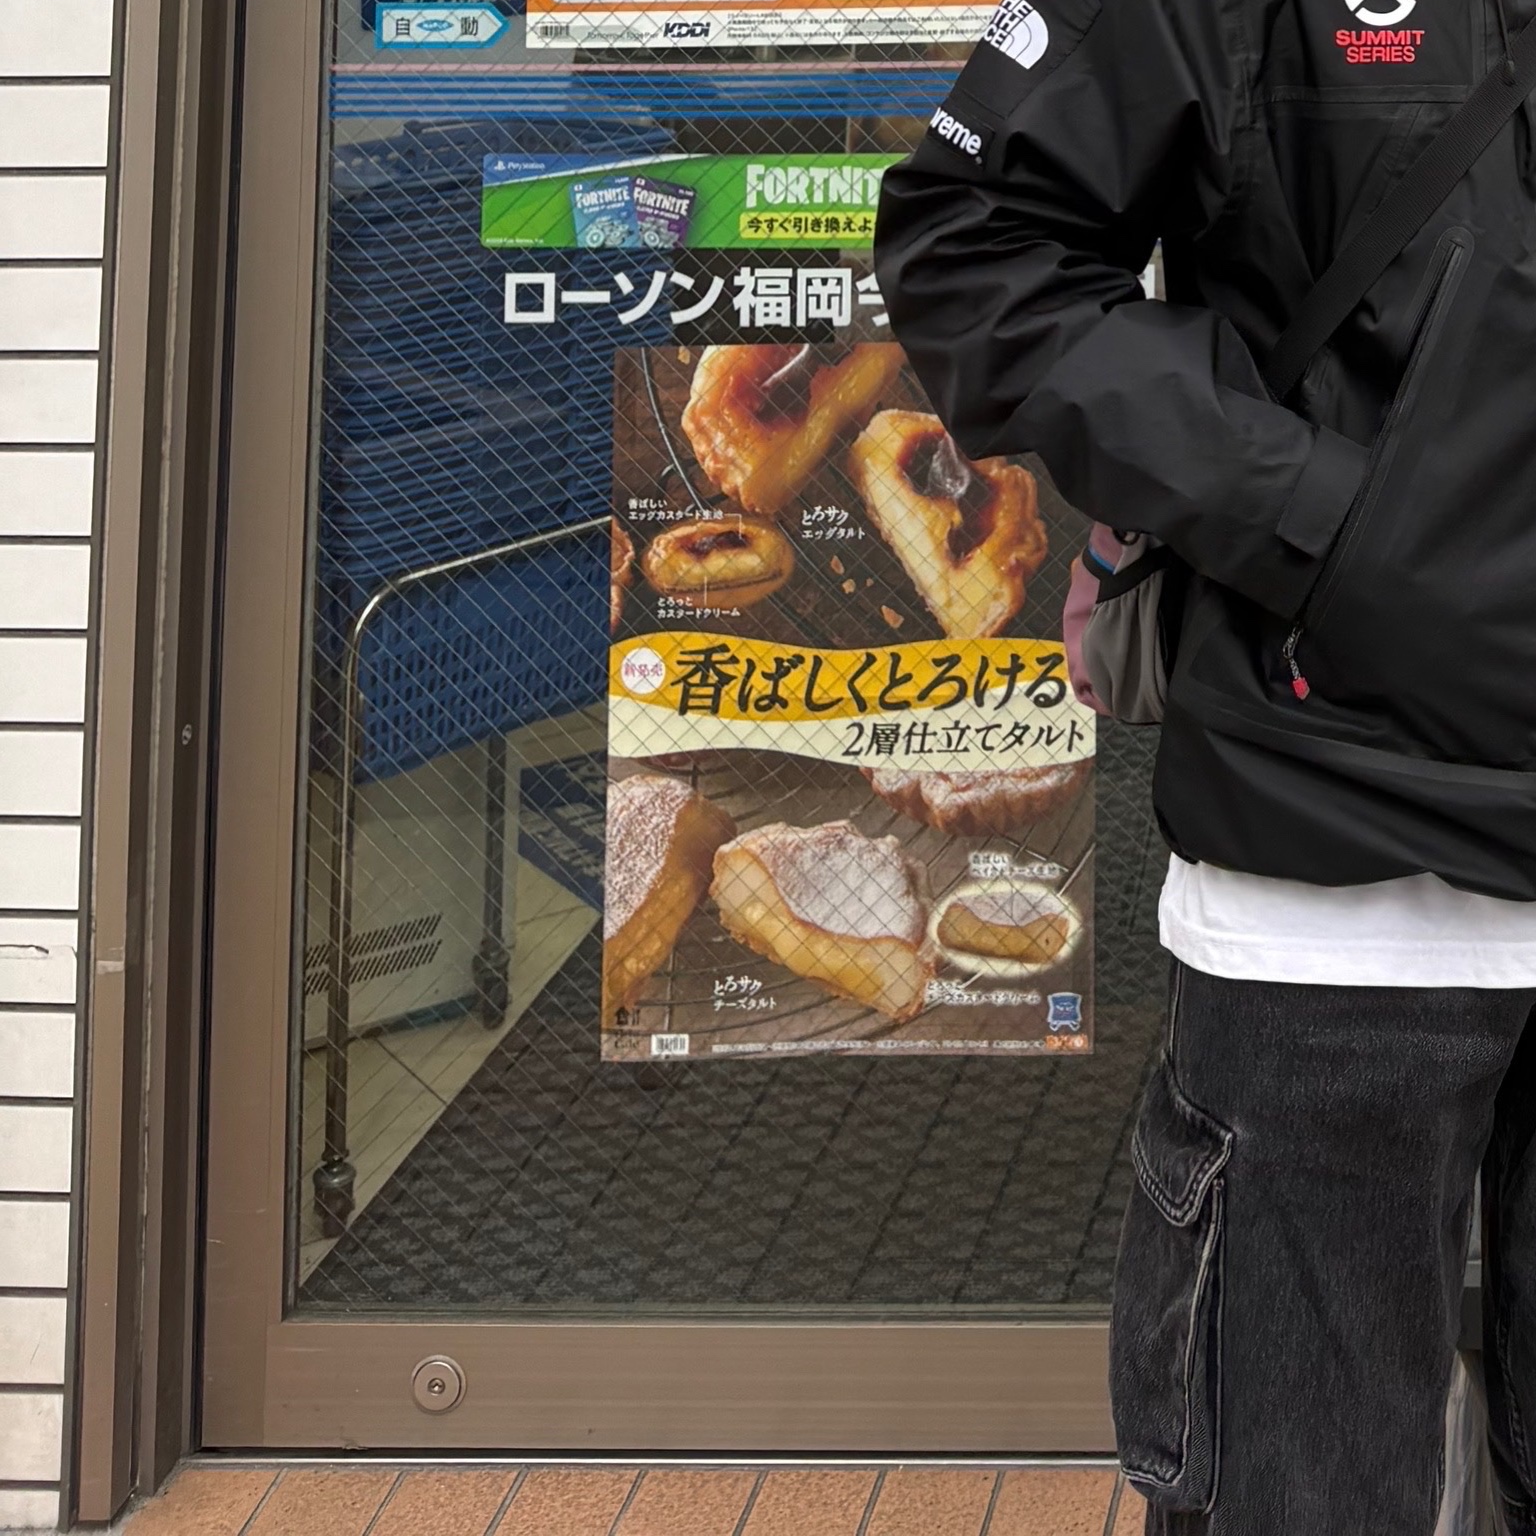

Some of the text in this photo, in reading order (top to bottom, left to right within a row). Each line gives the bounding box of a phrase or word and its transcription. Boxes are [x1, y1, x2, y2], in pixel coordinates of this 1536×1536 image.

[663, 22, 711, 38] KDDI
[1336, 30, 1425, 47] SUMMIT
[1346, 46, 1416, 63] SERIES
[930, 107, 982, 155] reme
[746, 164, 887, 208] FORTNIT
[575, 186, 630, 208] FORTNITE
[634, 186, 690, 216] FORTNITE
[747, 218, 876, 234] 今すぐ引き換えよ
[628, 498, 667, 509] 香ばしい
[802, 505, 849, 526] とろサク
[802, 527, 865, 540] エッグタルト
[658, 597, 693, 607] とろっと
[657, 608, 741, 619] カスタードクリーム
[670, 644, 1067, 716] 香ばしくとろける
[842, 720, 1085, 758] 2層仕立てタルト
[714, 976, 763, 996] とろサク
[714, 997, 777, 1011] チーズタルト
